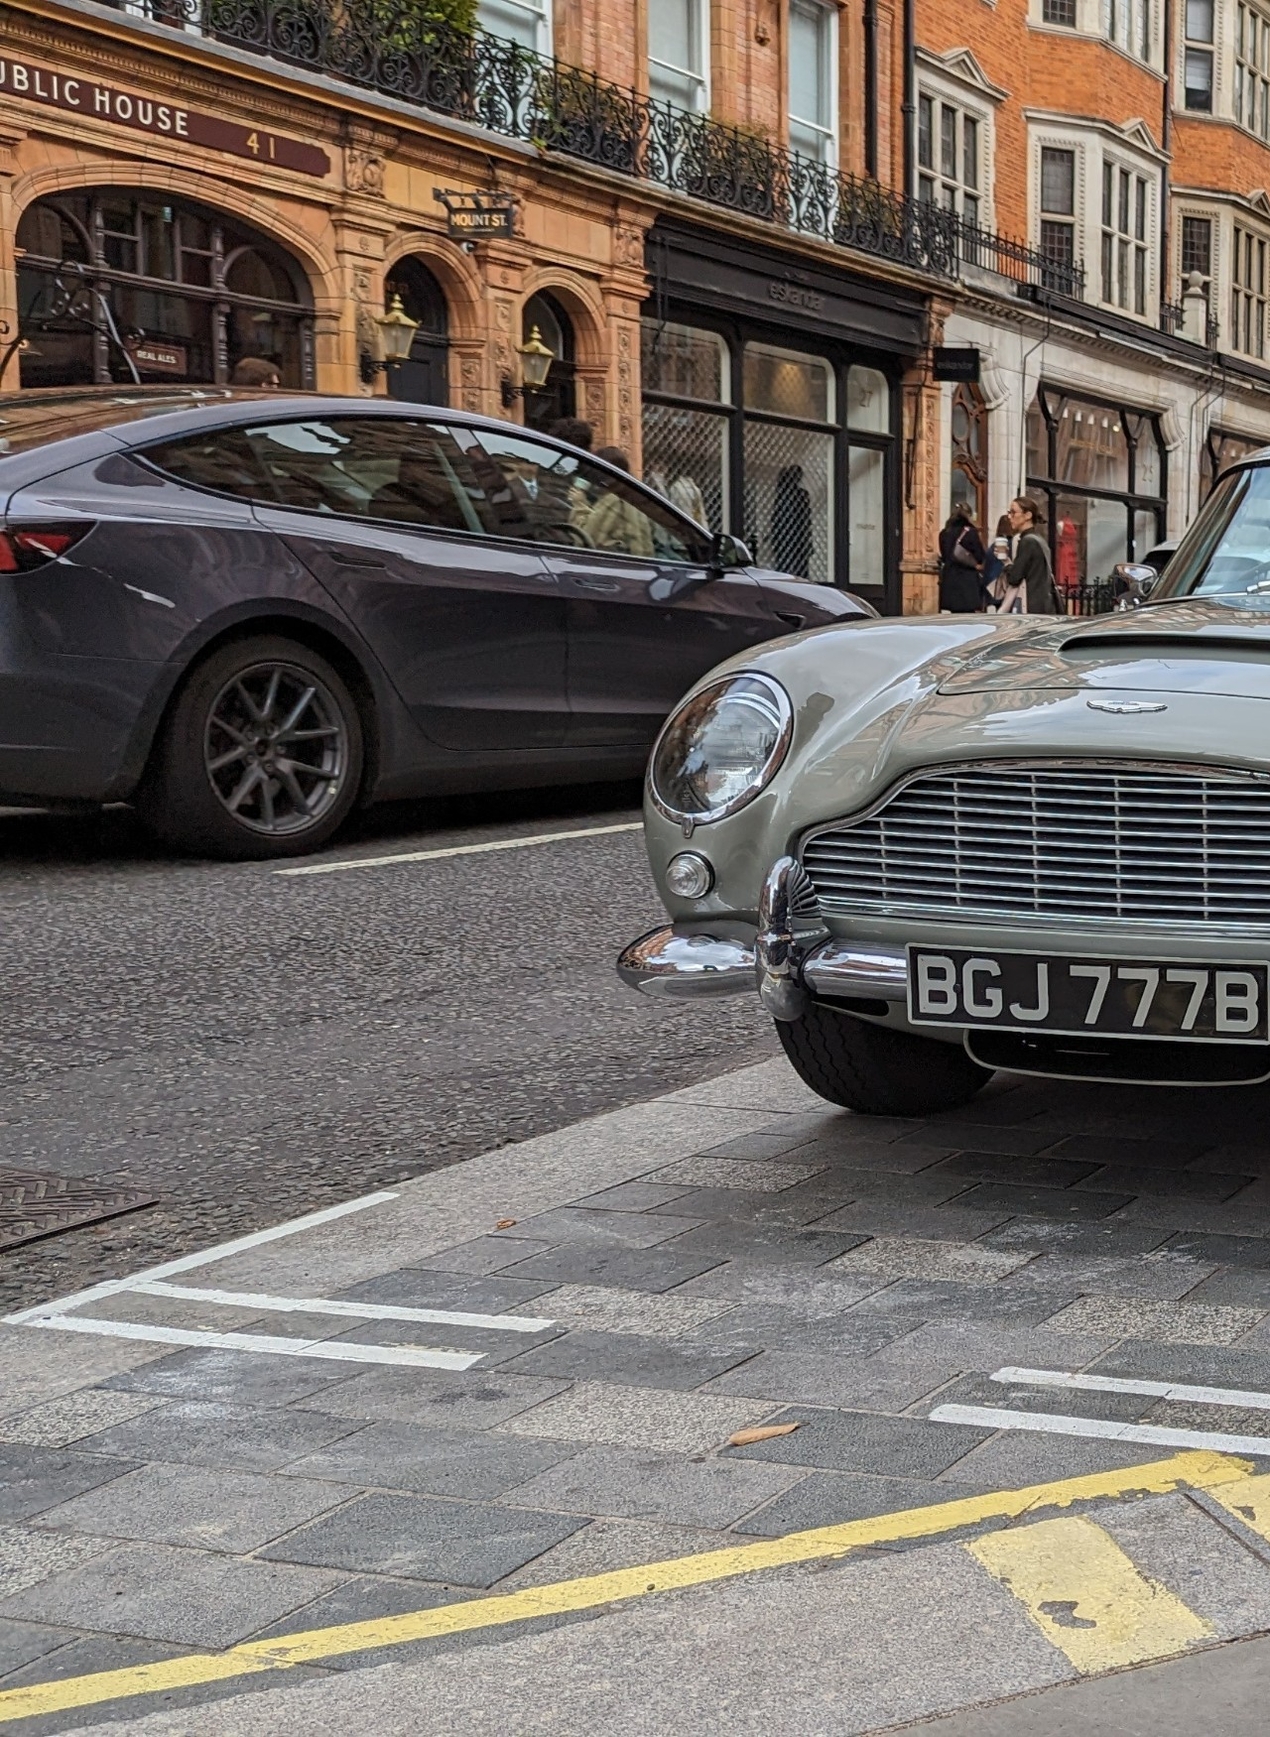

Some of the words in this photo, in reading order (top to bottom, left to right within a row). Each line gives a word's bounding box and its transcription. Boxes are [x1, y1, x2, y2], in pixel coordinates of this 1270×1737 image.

[94, 87, 189, 136] HOUSE
[246, 132, 276, 159] 41
[451, 213, 490, 226] MOUNT
[491, 213, 509, 227] ST.
[136, 350, 157, 361] REAL
[157, 353, 177, 364] ALES
[917, 953, 1050, 1021] BGJ
[1069, 964, 1259, 1034] 777B
